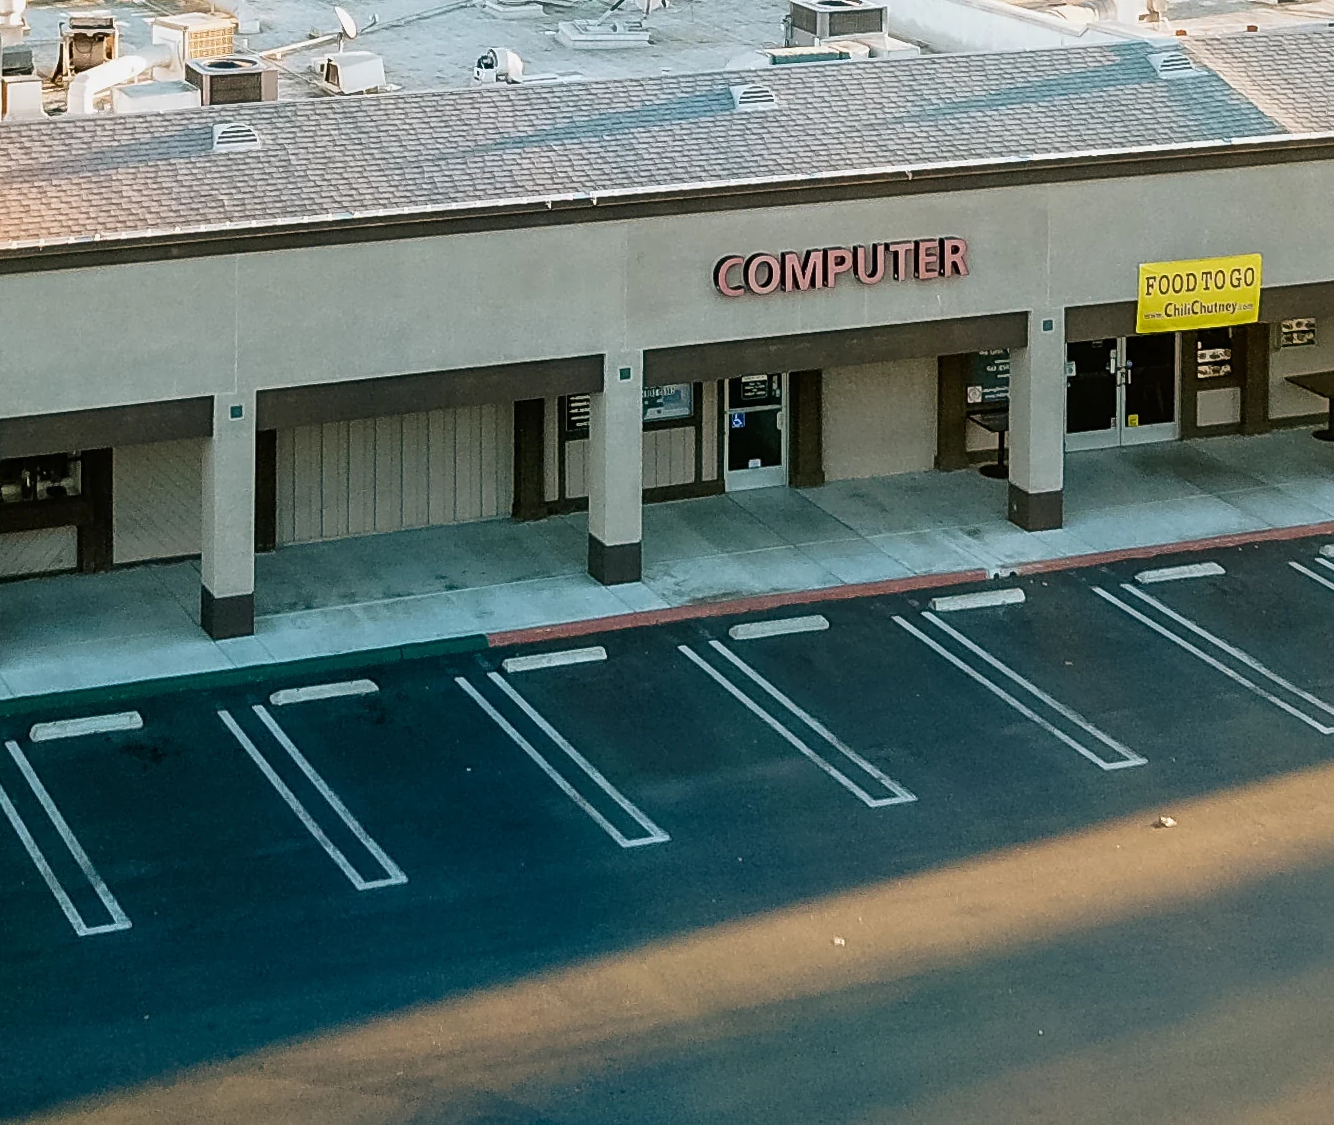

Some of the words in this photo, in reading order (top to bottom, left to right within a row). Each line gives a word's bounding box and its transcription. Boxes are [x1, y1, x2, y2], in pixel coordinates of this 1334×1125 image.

[713, 236, 969, 297] COMPUTER
[1145, 272, 1198, 296] FOOD
[1201, 269, 1226, 291] TO
[1230, 267, 1255, 289] GO
